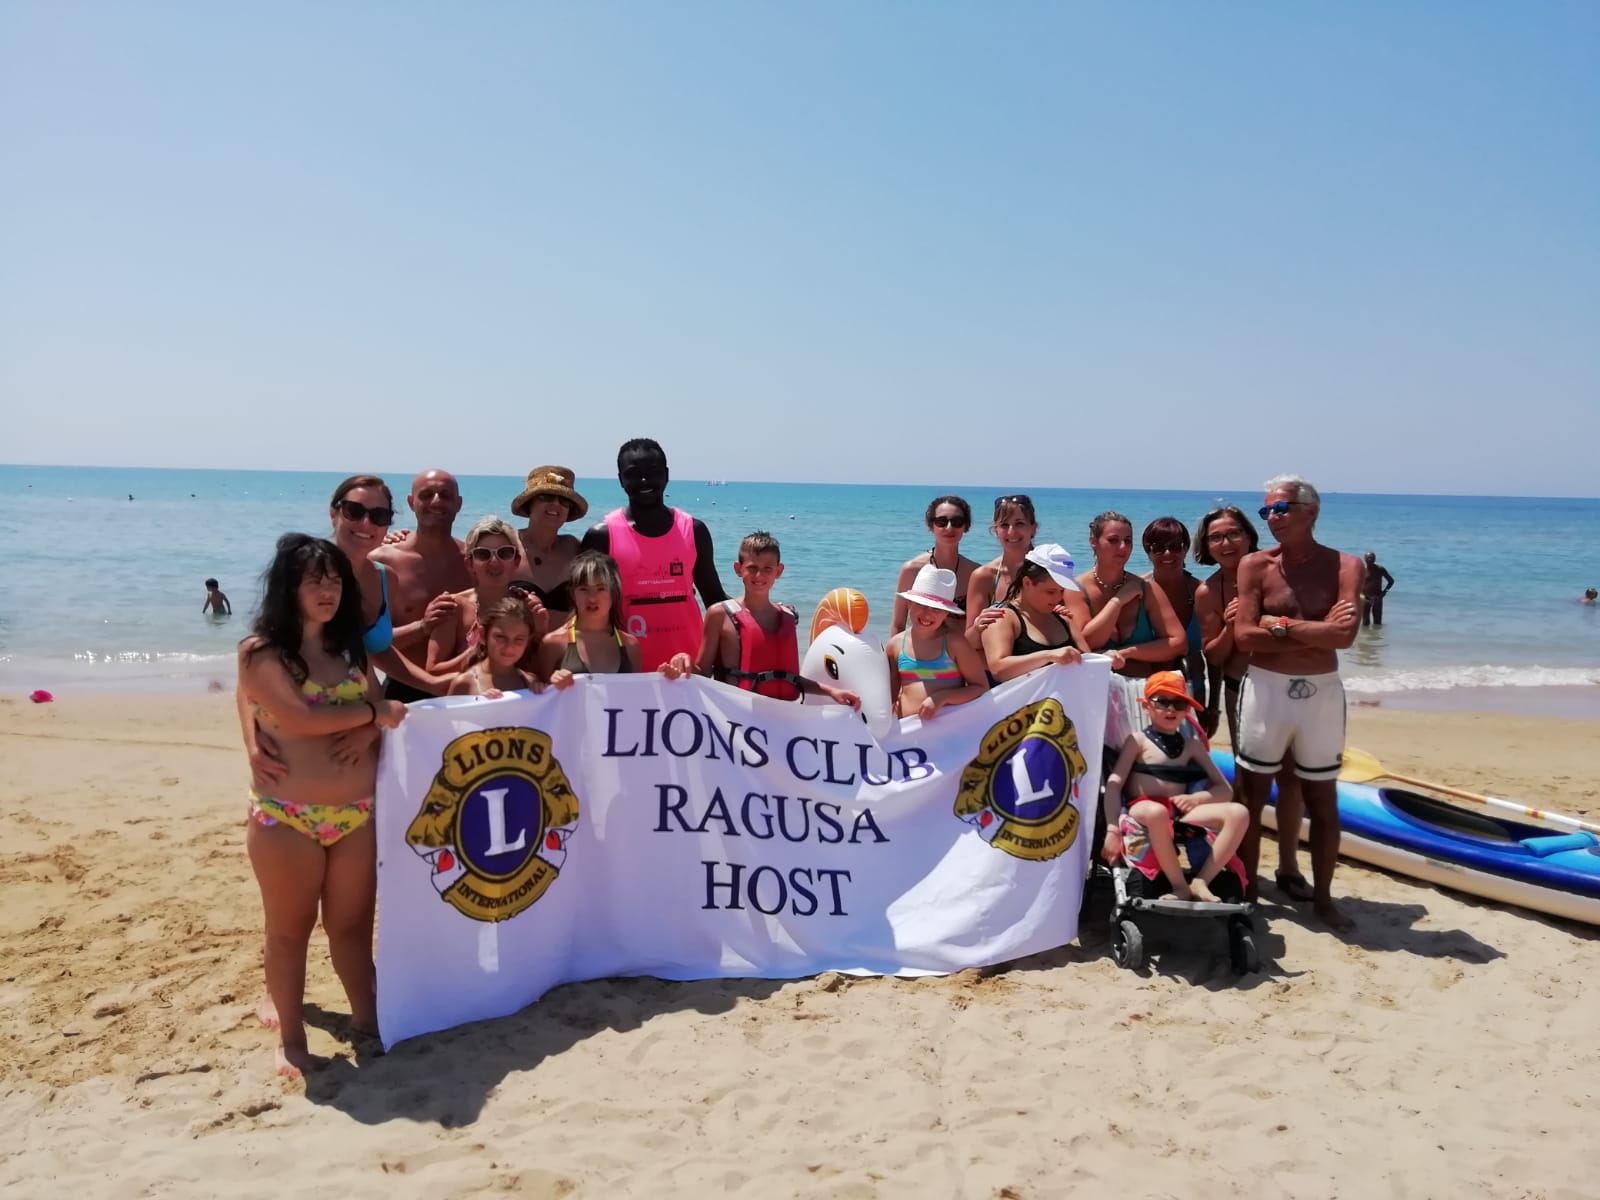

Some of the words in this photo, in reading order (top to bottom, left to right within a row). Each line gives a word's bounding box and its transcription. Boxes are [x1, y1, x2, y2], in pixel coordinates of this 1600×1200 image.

[453, 738, 545, 776] LIONS
[601, 708, 770, 768] LIONS
[785, 735, 935, 787] CLUB
[986, 707, 1055, 754] LIONS
[1005, 747, 1055, 807] L
[479, 787, 527, 857] L
[652, 783, 891, 845] RAGUSA
[1000, 813, 1077, 850] INTERNATIONAL
[456, 866, 548, 910] INTERNATIONAL
[700, 860, 852, 917] HOST
